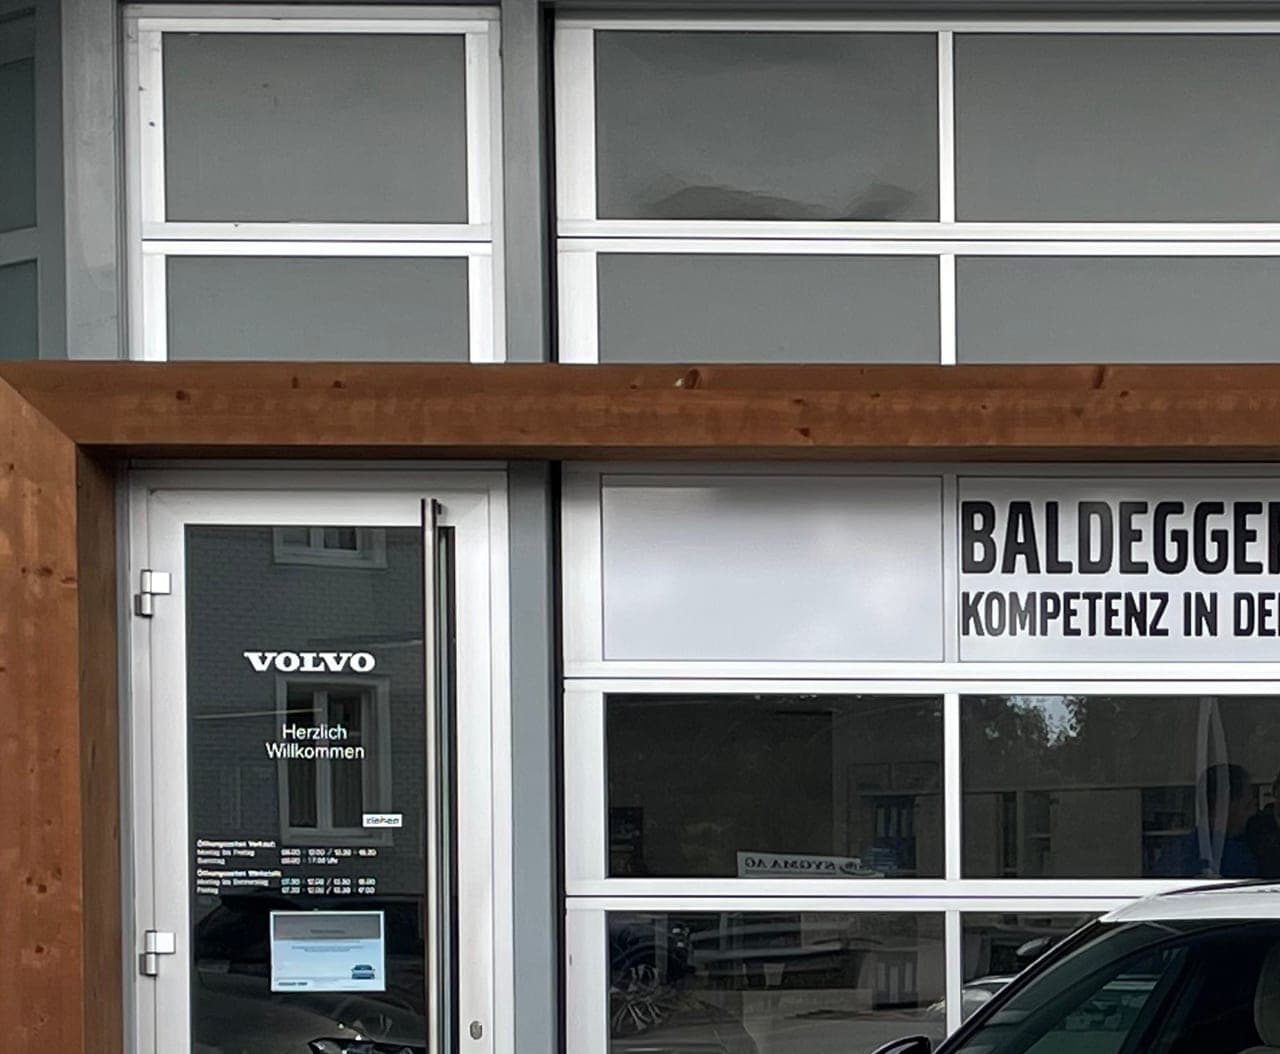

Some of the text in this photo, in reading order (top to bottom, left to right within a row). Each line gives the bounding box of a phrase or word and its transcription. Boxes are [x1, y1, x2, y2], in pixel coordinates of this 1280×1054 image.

[961, 591, 1169, 637] KOMPETENZ
[1184, 592, 1218, 637] IN
[244, 652, 376, 672] VOLVO
[282, 724, 347, 740] Herzlich
[266, 743, 365, 759] Willkommen
